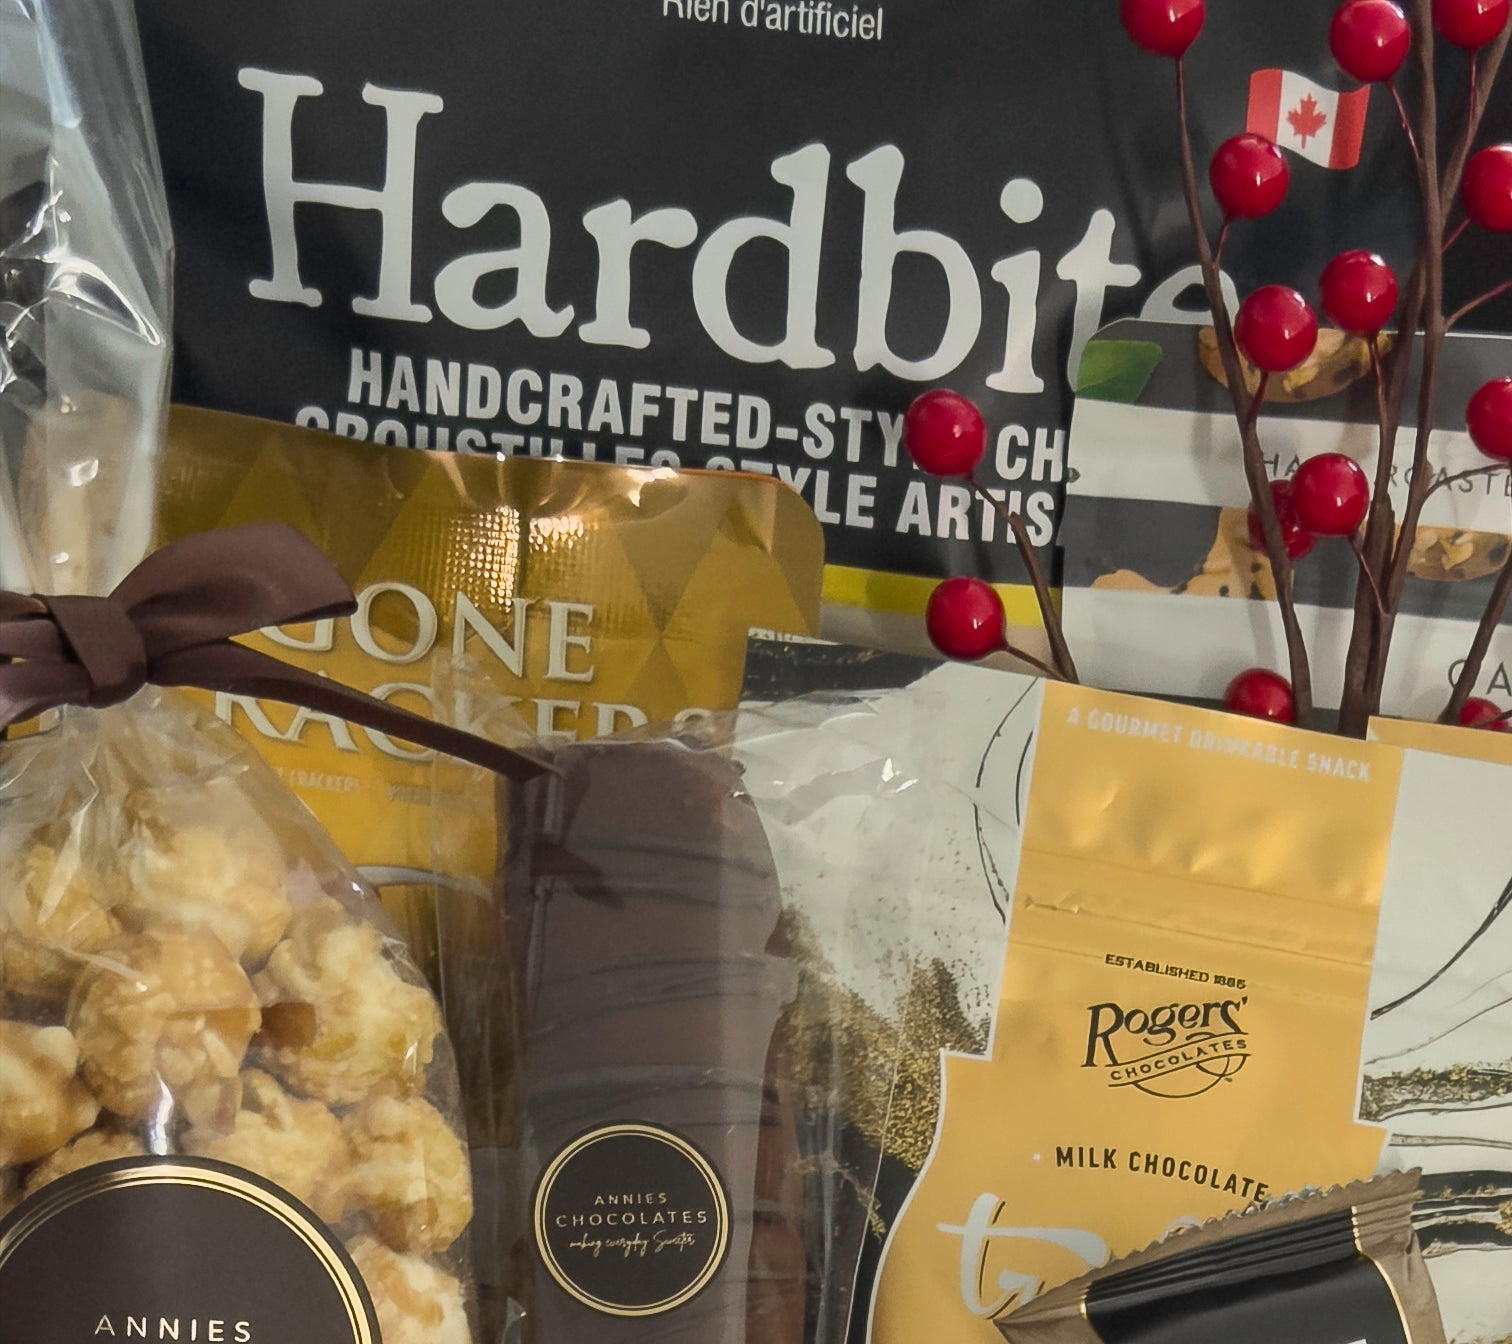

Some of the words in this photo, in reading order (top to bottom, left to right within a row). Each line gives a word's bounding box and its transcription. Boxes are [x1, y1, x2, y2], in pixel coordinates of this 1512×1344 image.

[741, 0, 883, 40] d'artificiel
[347, 347, 922, 470] HANDCRAFTED-STY
[1066, 706, 1080, 726] A
[1087, 708, 1184, 744] GOURMET
[1189, 727, 1299, 769] DRINKABLE
[1307, 752, 1371, 783] SNACK
[1105, 953, 1210, 983] ESTABLISHED
[1110, 1039, 1248, 1081] CHOCOLATES
[1055, 1146, 1117, 1169] MILK
[1129, 1151, 1269, 1203] CHOCOLATE
[556, 1210, 708, 1228] CHOCOLATES
[594, 1192, 668, 1206] ANNIES
[94, 1313, 251, 1343] ANNIES
